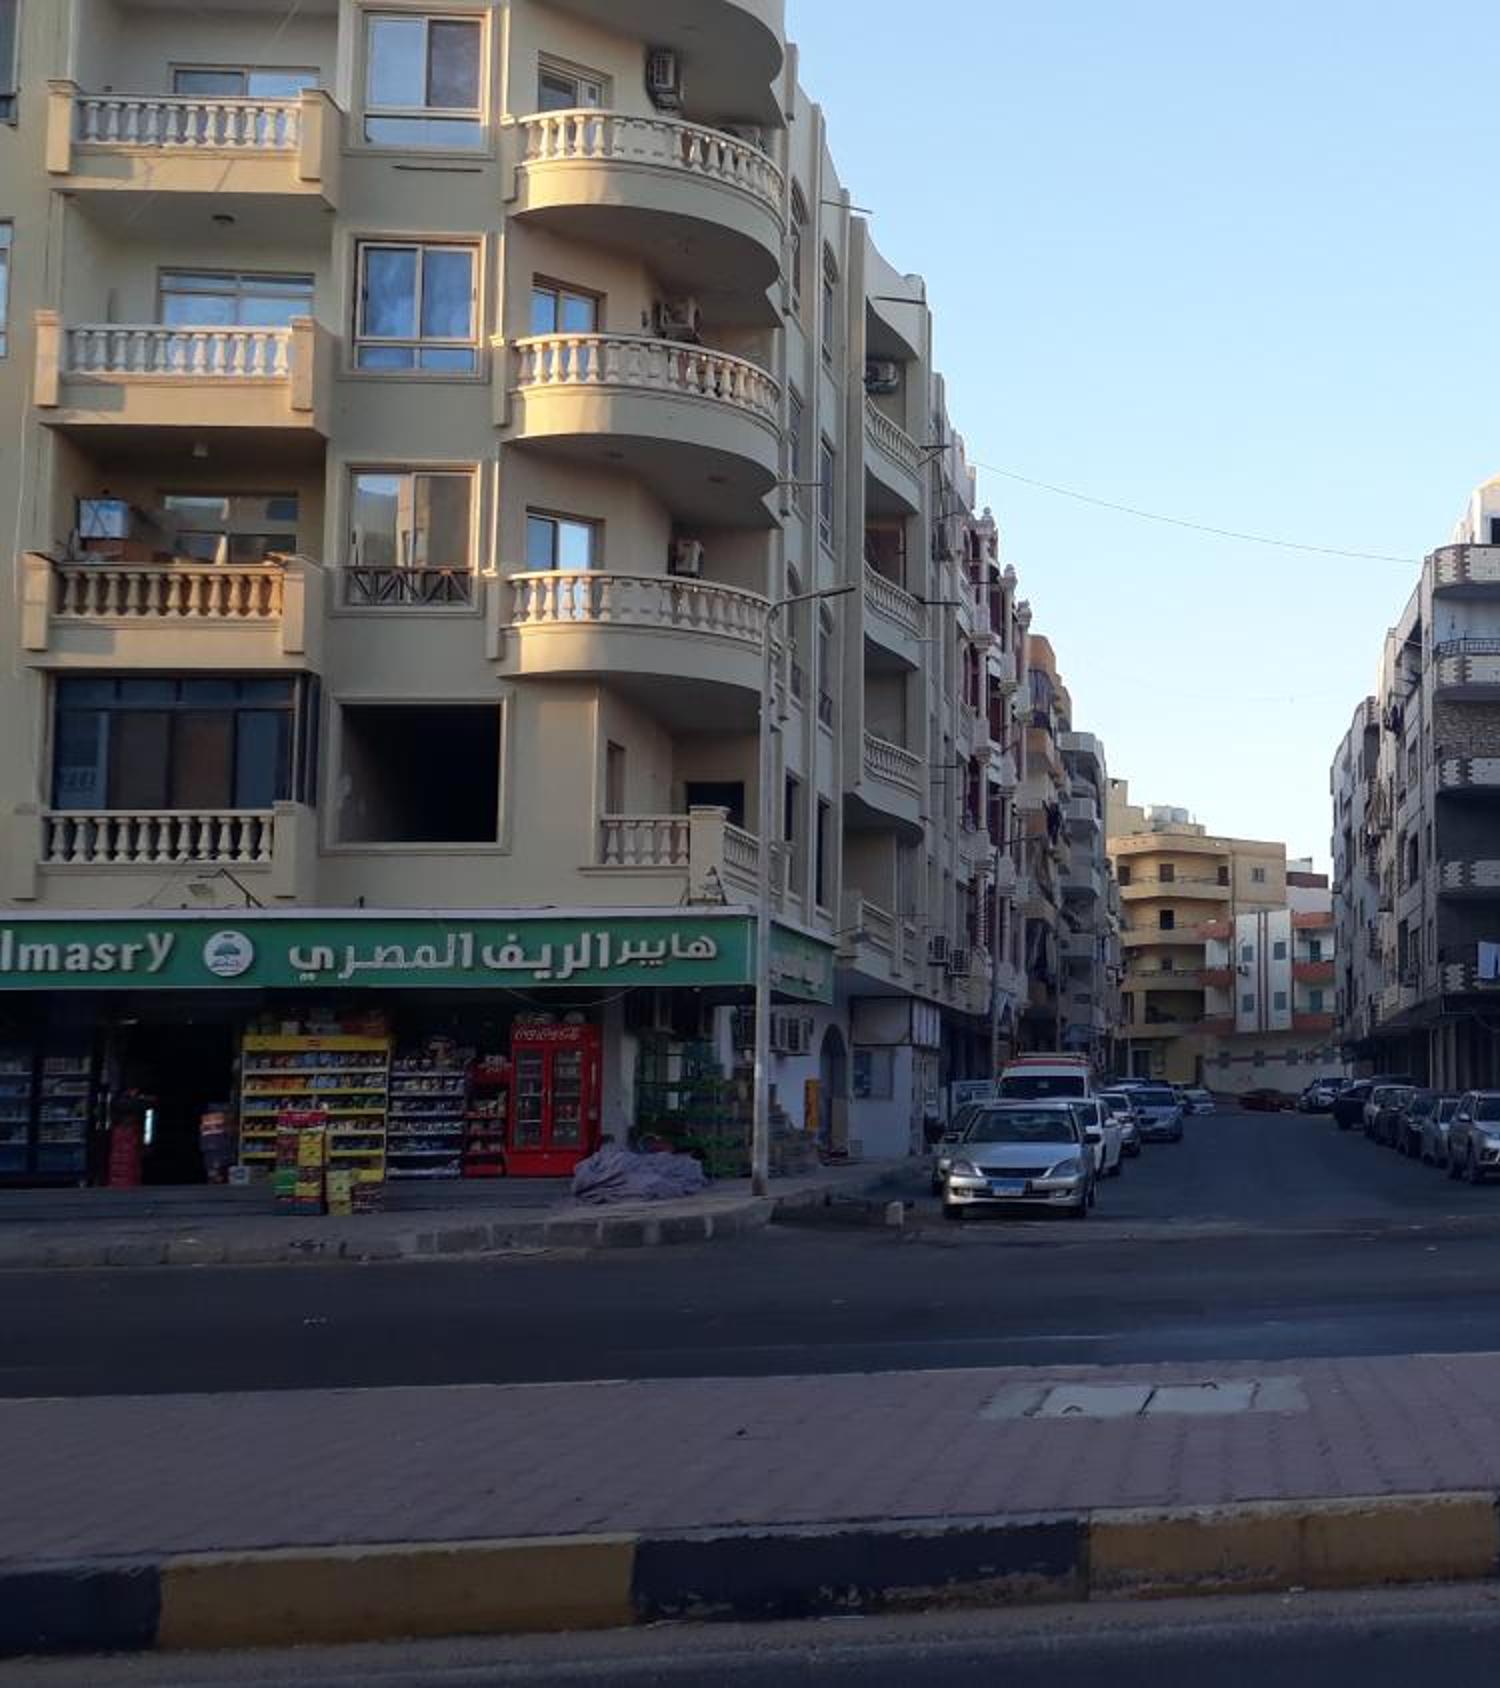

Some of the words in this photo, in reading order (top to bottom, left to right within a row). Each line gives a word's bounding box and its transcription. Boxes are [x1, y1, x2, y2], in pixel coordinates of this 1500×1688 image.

[288, 932, 474, 982] المصري
[480, 931, 610, 980] الريف
[615, 932, 719, 967] هايبر
